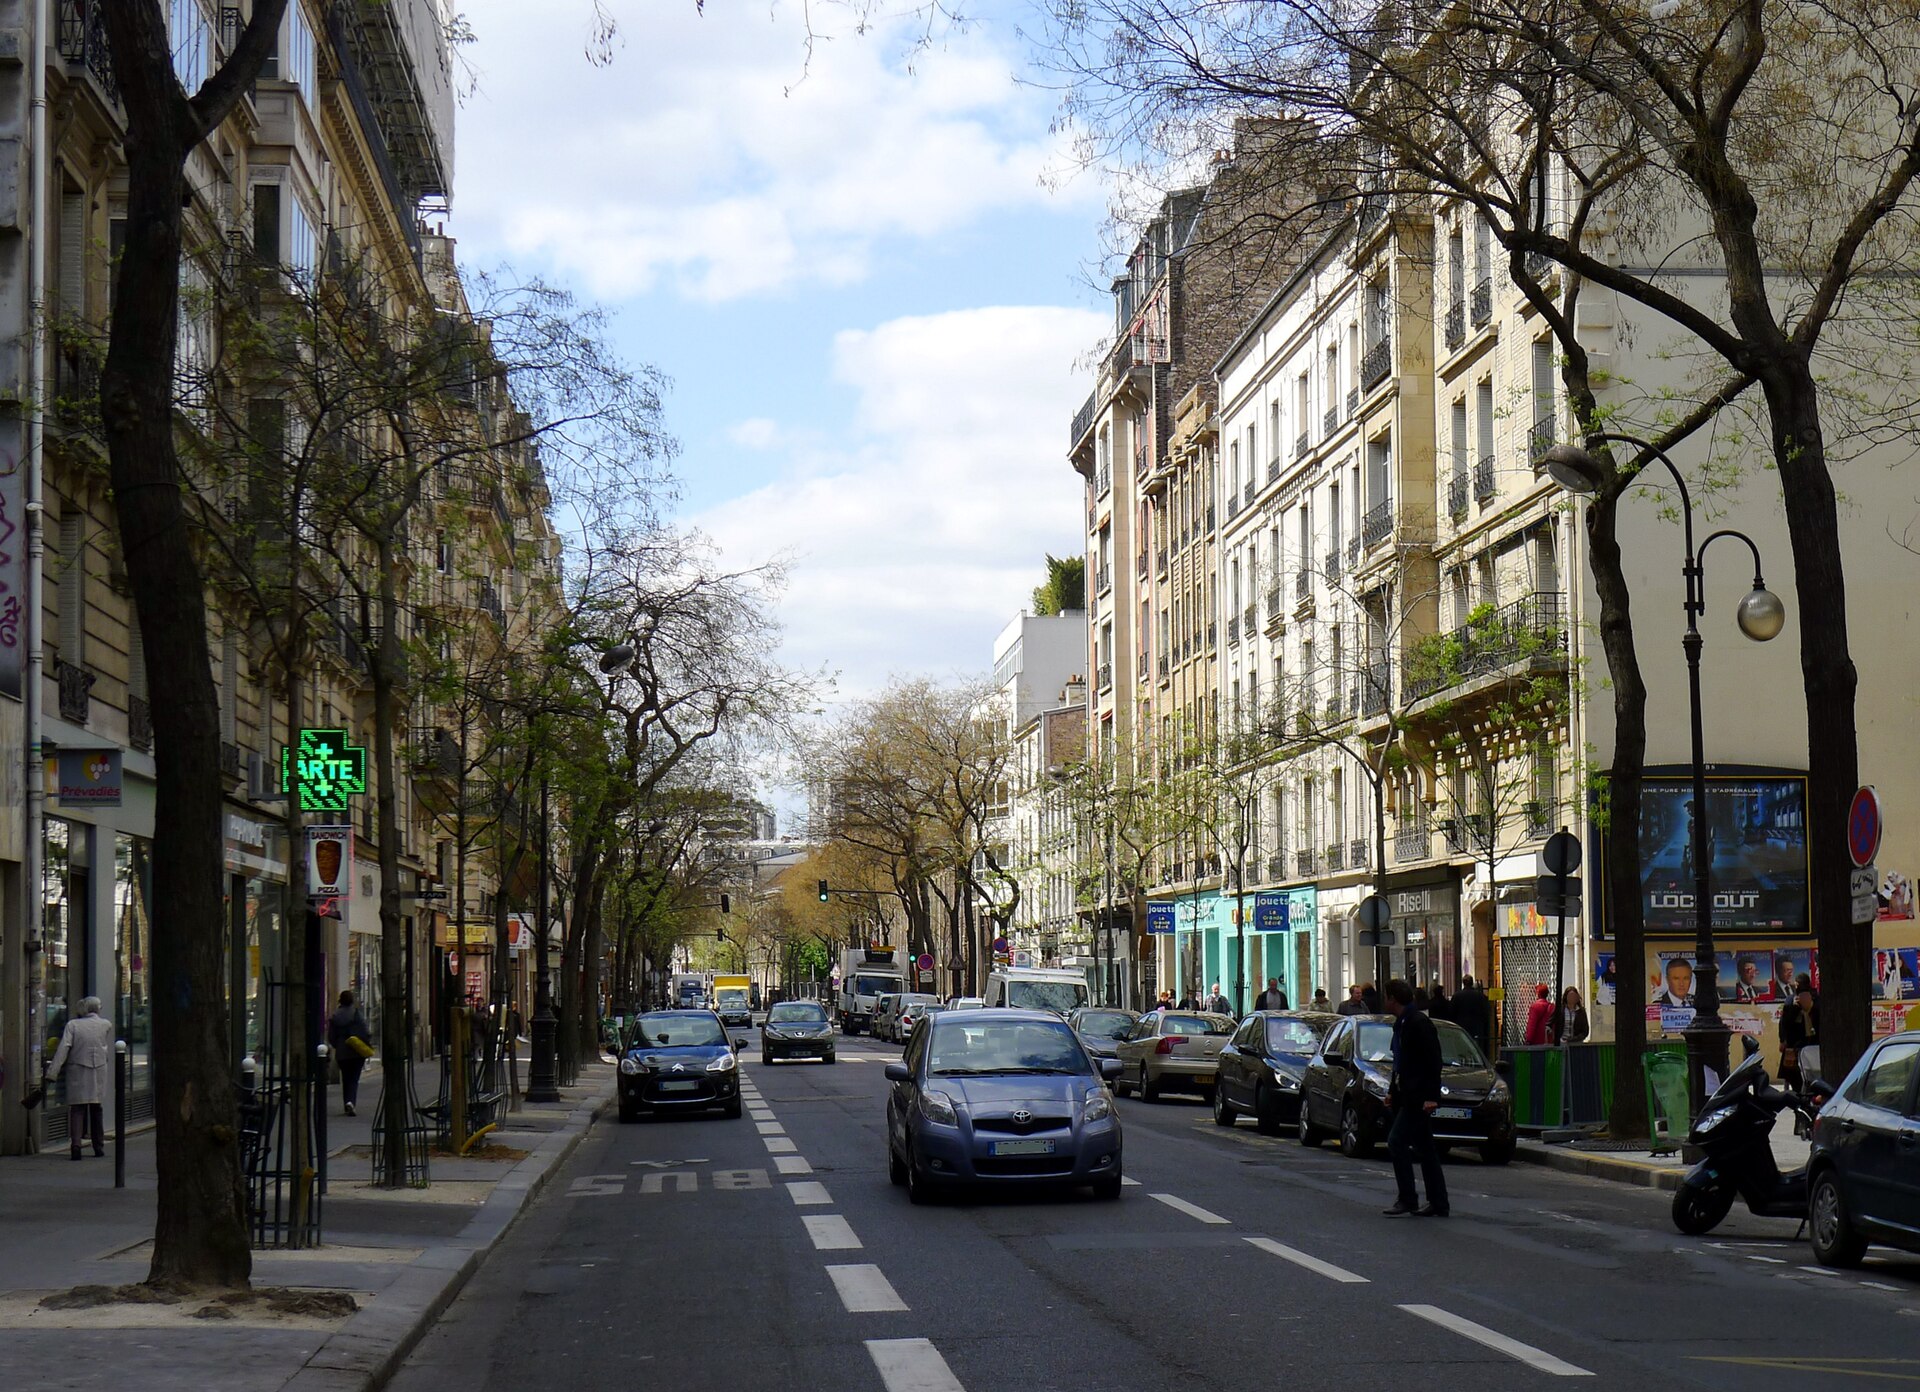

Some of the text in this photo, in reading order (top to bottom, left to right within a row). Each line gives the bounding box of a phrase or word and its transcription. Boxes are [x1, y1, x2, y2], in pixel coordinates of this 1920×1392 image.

[311, 831, 347, 840] SANDWICH
[1257, 896, 1289, 906] jouets
[1398, 890, 1431, 913] Riselli
[1651, 894, 1760, 908] LOC OUT
[1148, 905, 1175, 914] jouets
[565, 1168, 772, 1197] BUS
